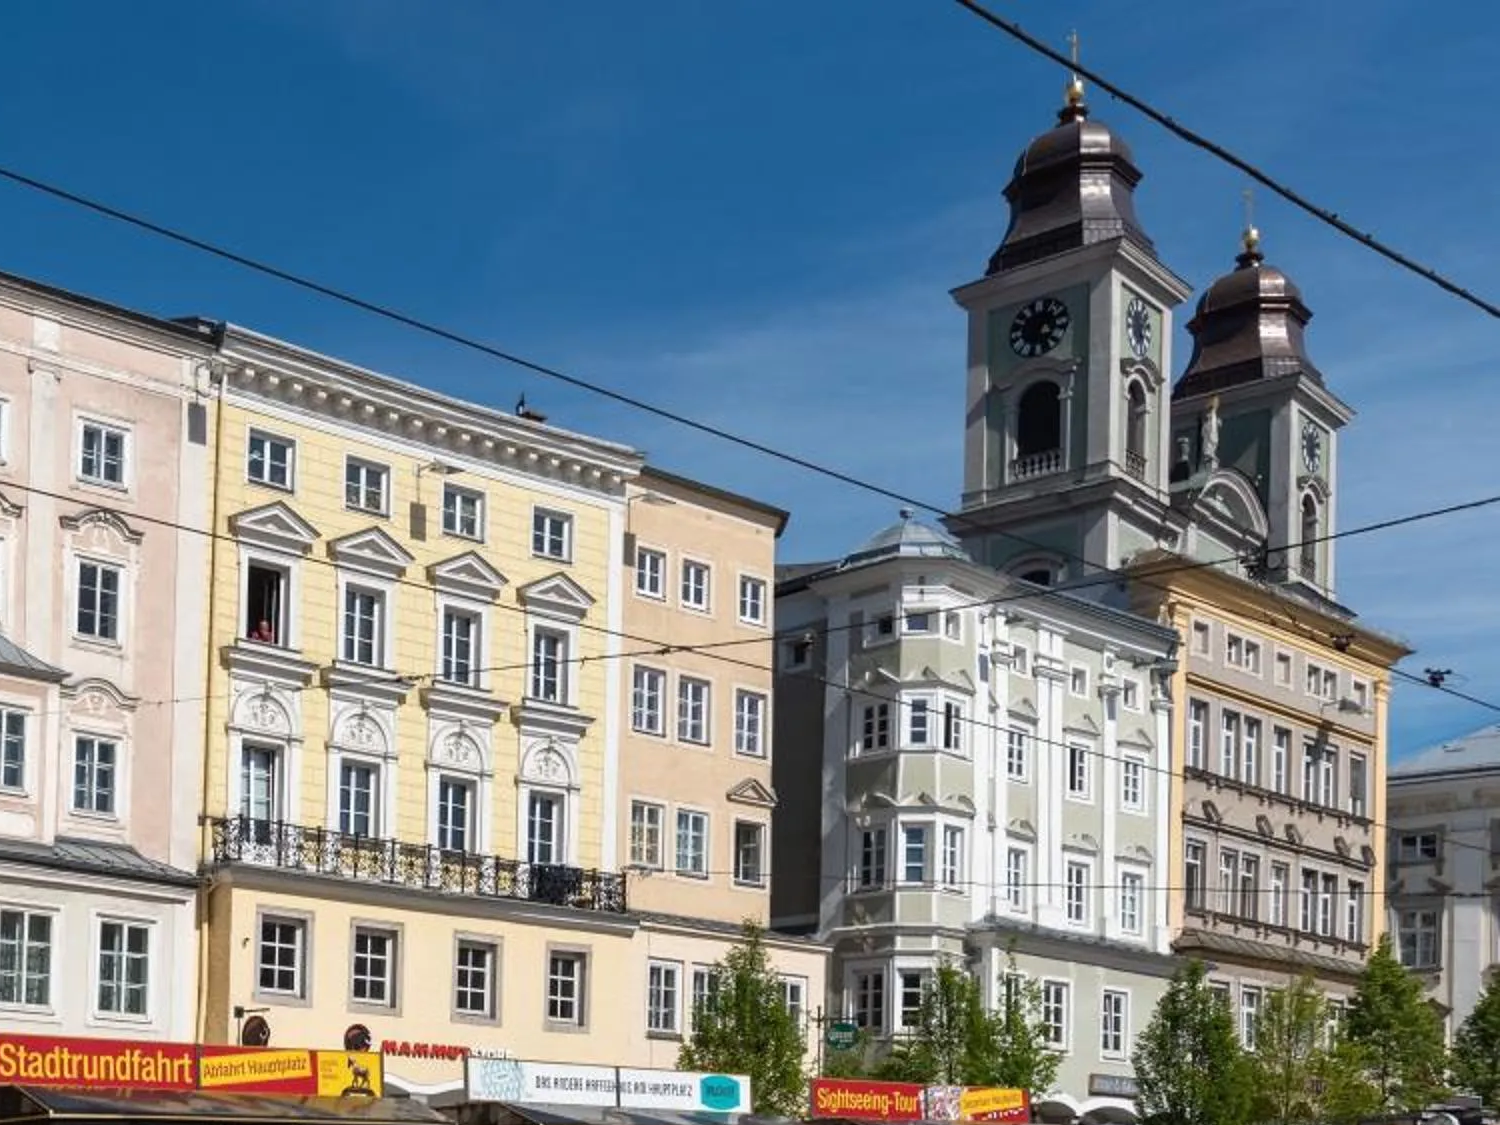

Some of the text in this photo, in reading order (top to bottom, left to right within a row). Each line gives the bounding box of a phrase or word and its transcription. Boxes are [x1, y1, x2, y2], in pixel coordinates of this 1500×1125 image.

[381, 1040, 470, 1061] MAMMUT
[249, 1055, 307, 1076] Hauptplatz
[535, 1075, 551, 1089] DAS
[585, 1079, 632, 1094] KAFFEEHUS
[648, 1083, 692, 1097] HAUPTPLATZ
[817, 1088, 918, 1114] Sightseeing-Tour
